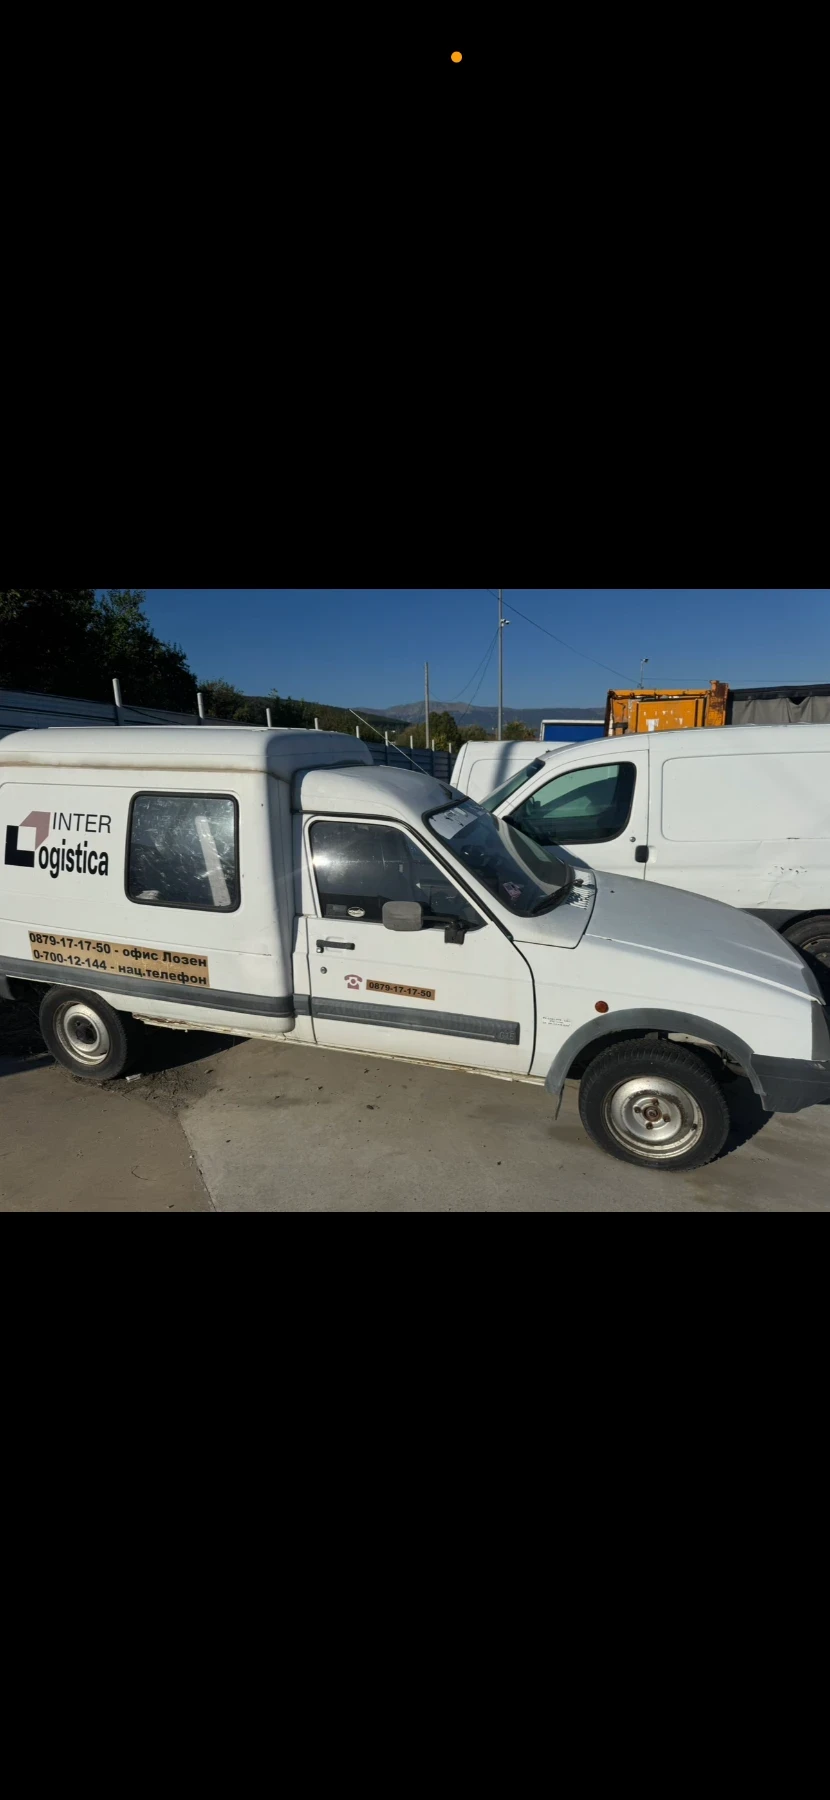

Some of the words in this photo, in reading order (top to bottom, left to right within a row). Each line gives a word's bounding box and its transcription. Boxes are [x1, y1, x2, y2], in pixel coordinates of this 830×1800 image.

[52, 811, 112, 834] INTER
[29, 932, 111, 954] 0879-17-17-50
[122, 947, 159, 961] офис
[162, 951, 207, 967] Лозен
[33, 949, 107, 971] 0-700-12-144
[118, 964, 207, 985] нац.телефон
[368, 981, 432, 998] 0879-17-17-50
